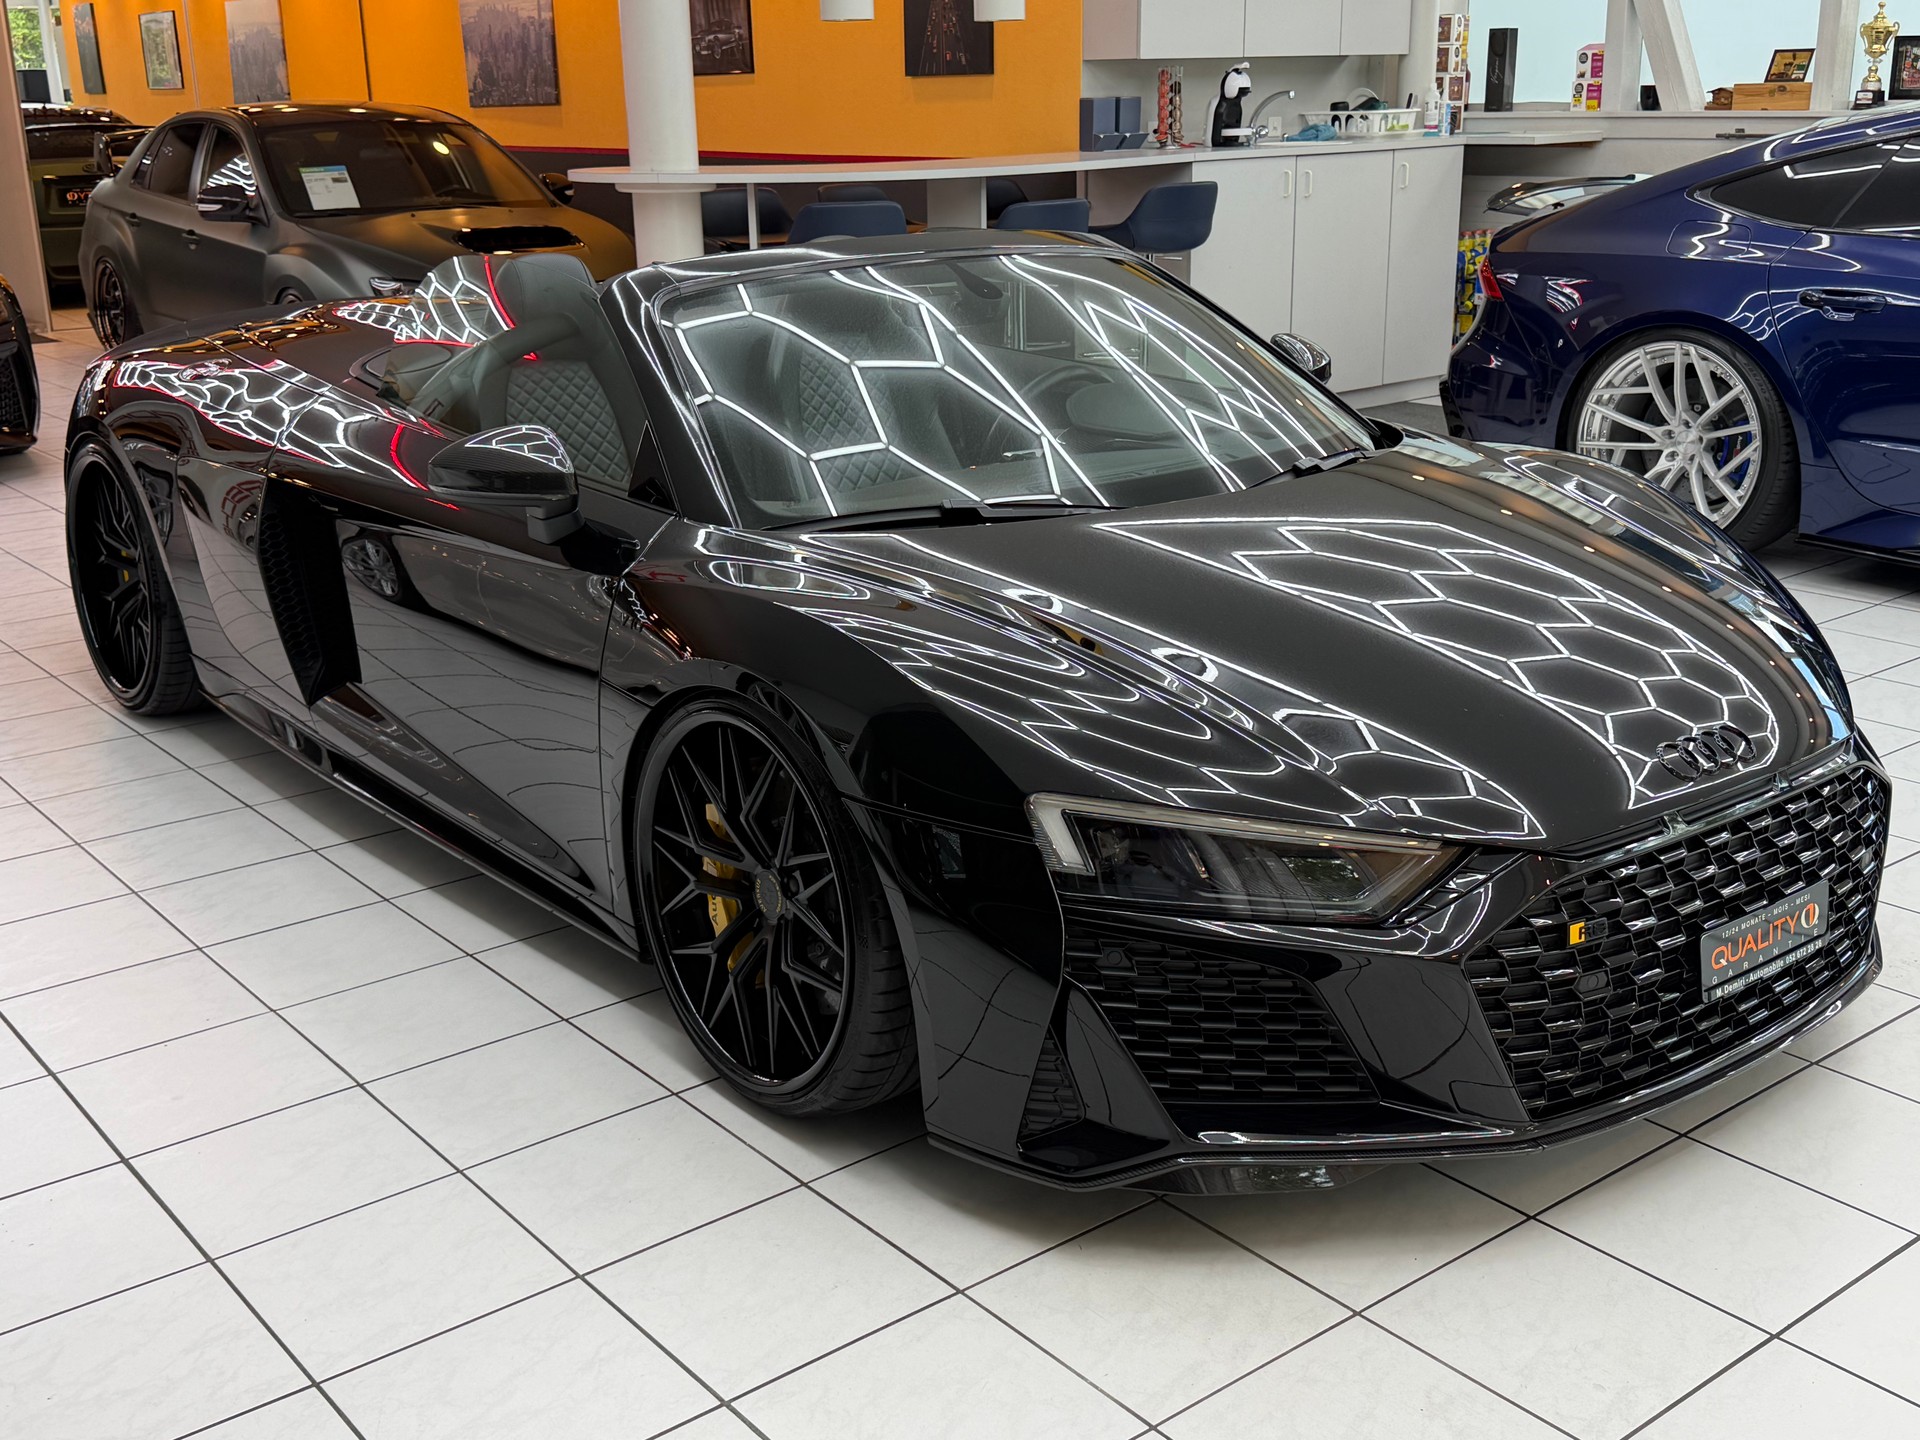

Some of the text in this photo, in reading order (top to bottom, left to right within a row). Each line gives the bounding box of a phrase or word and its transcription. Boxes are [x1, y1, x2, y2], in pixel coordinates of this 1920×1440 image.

[1711, 911, 1800, 970] QUALITY
[1722, 926, 1739, 939] 12/24
[1741, 914, 1766, 931] MONATE
[1773, 903, 1789, 916] MOIS
[1796, 893, 1811, 905] MESI
[1711, 928, 1818, 985] GARANTIE
[1724, 979, 1746, 994] Demiri
